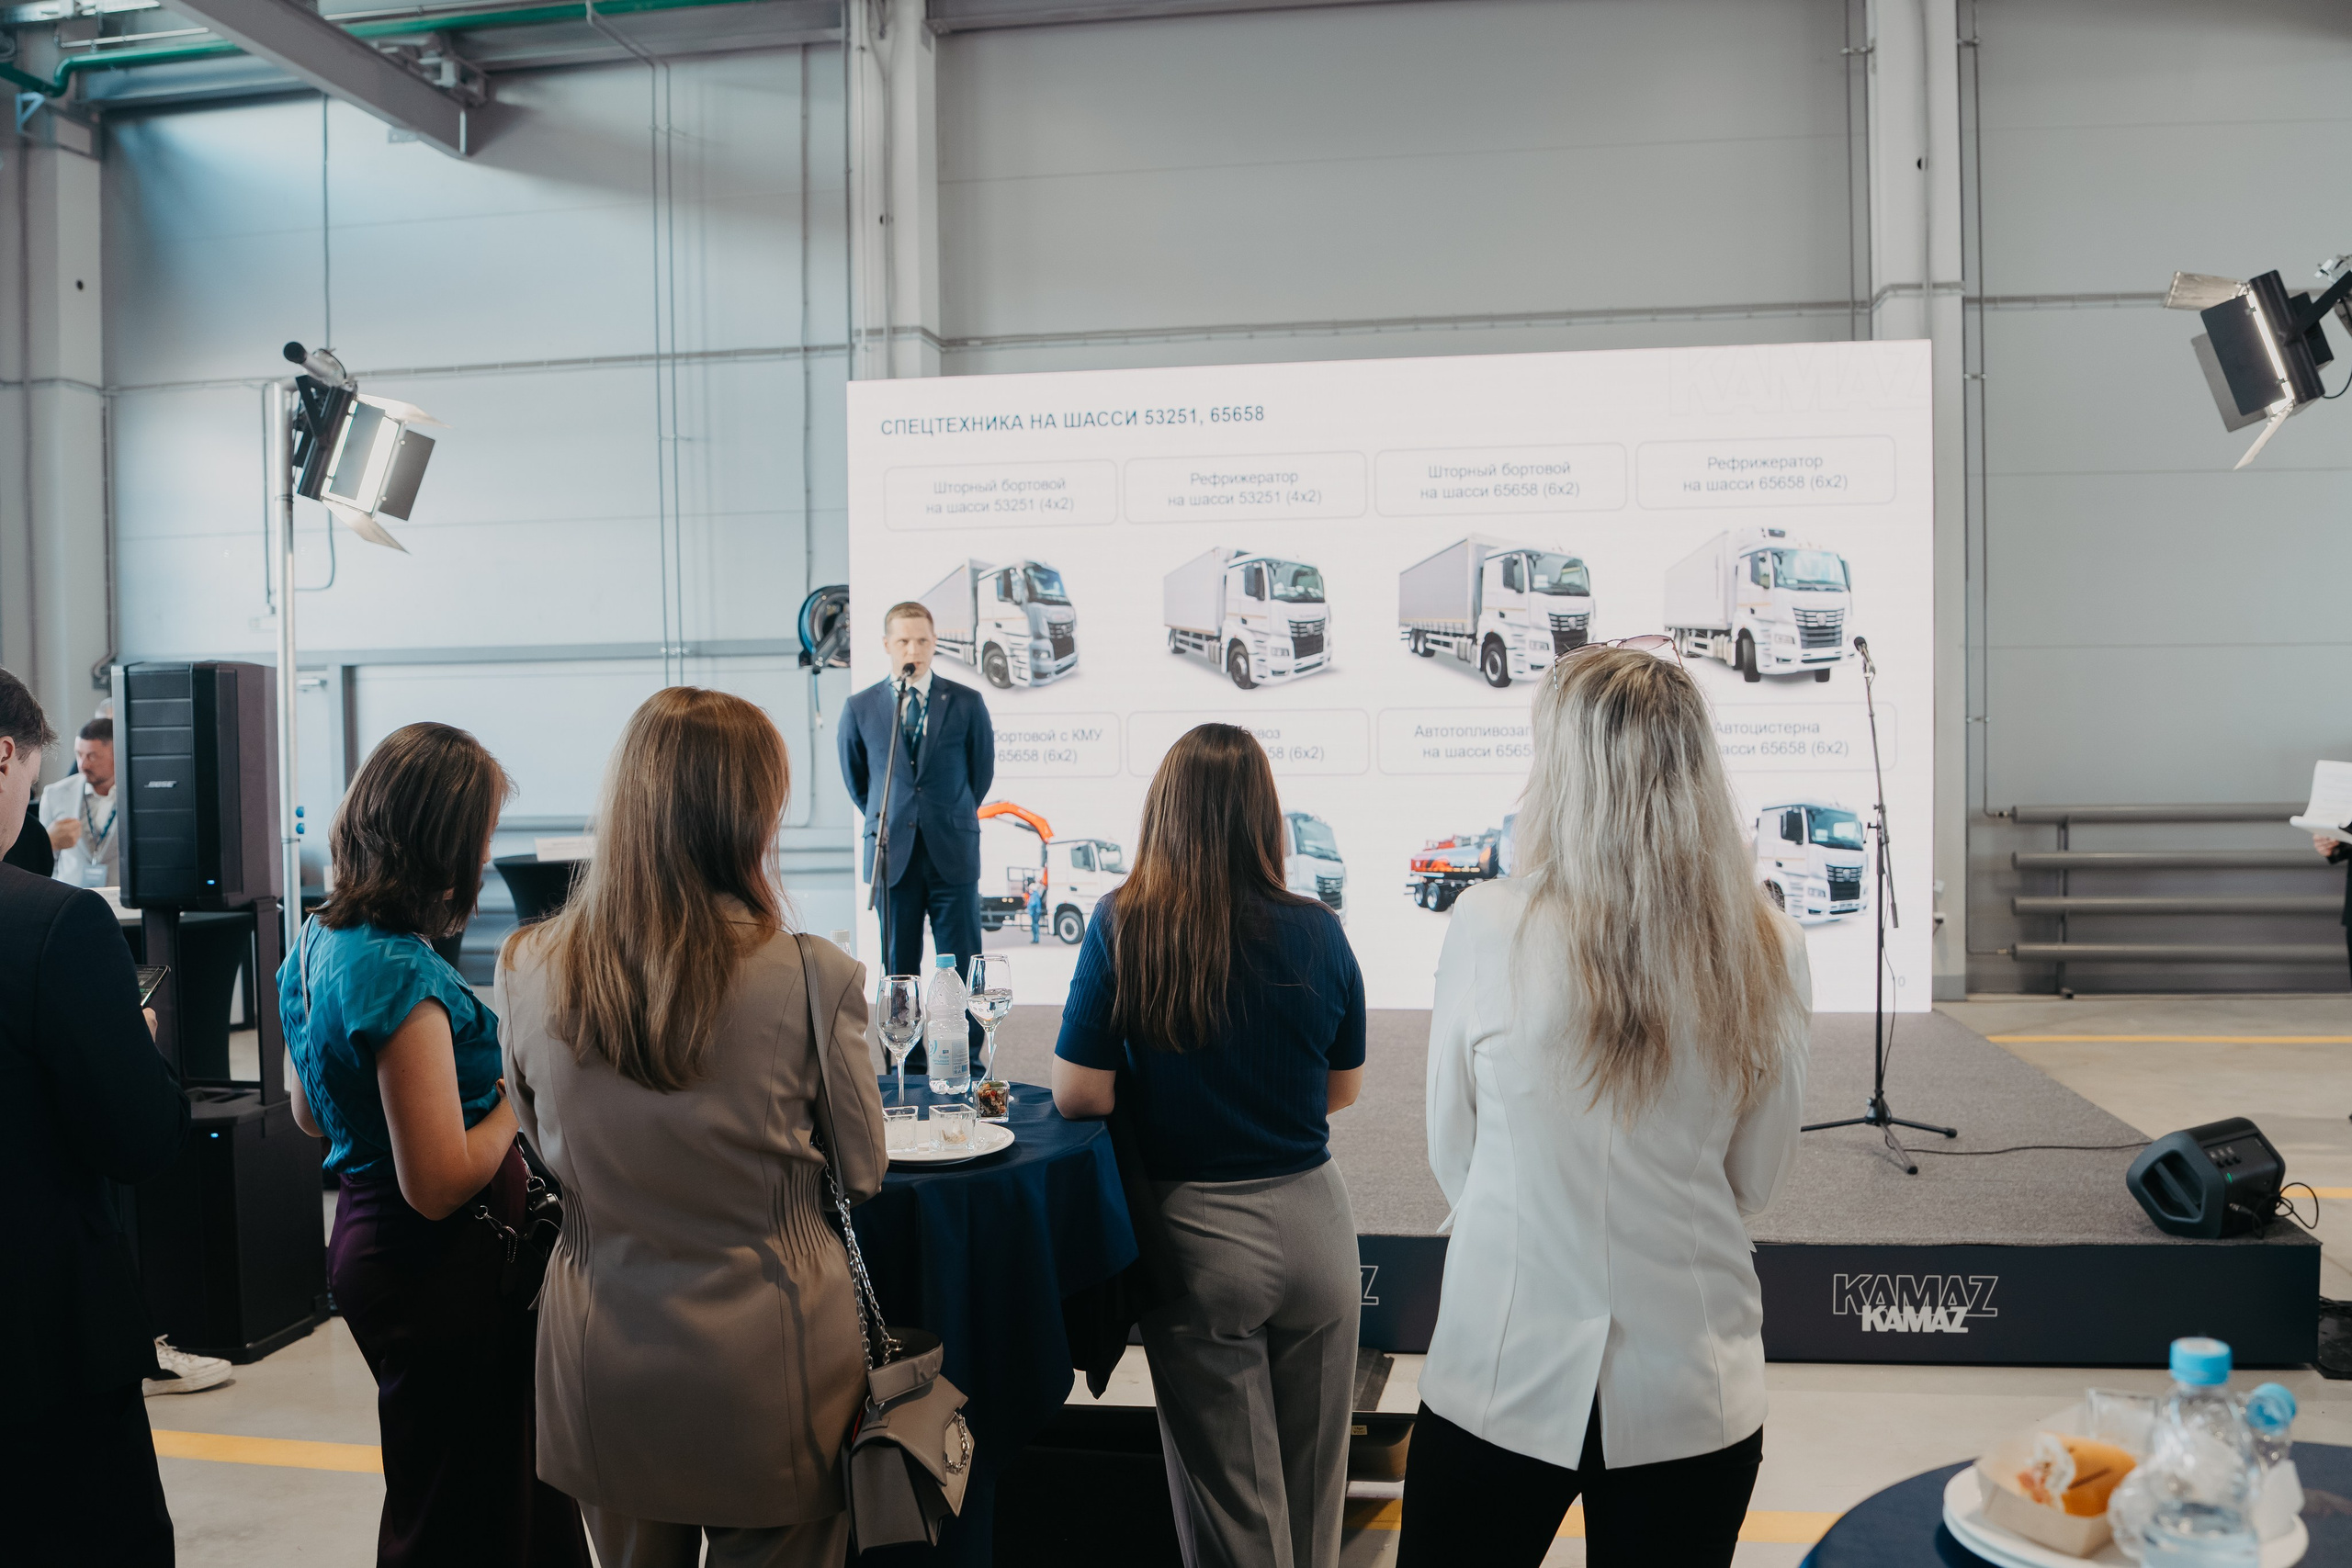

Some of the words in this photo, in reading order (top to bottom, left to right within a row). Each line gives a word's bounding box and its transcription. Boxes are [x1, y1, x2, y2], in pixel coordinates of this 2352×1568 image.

[881, 414, 1023, 436] СПЕЦТЕХНИКА
[1031, 413, 1057, 429] НА
[1064, 411, 1137, 428] ШАССИ
[1145, 408, 1204, 426] 53251,
[1211, 406, 1264, 423] 65658
[1429, 465, 1497, 479] Шторный
[1501, 462, 1571, 478] бортовой
[1708, 457, 1823, 472] Рефрижератор
[1190, 471, 1298, 487] Рефрижератор
[1683, 480, 1701, 491] на
[1707, 479, 1754, 491] шасси
[1759, 476, 1804, 490] 65658
[933, 480, 998, 496] Шторный
[1001, 478, 1066, 493] бортовой
[1420, 488, 1437, 499] на
[1442, 487, 1489, 499] шасси
[1494, 483, 1538, 497] 65658
[926, 502, 942, 513] на
[946, 502, 989, 513] шасси
[994, 499, 1034, 512] 53251
[1168, 495, 1184, 506] на
[1190, 494, 1234, 505] шасси
[1239, 491, 1281, 504] 53251
[1414, 724, 1532, 738] Автотопливозап
[1715, 721, 1820, 736] Автоцистерна
[993, 728, 1057, 745] бортовой
[1072, 728, 1102, 741] КМУ
[998, 750, 1038, 762] 65658
[1423, 746, 1440, 758] на
[1445, 746, 1491, 758] шасси
[1496, 743, 1533, 757] 6565
[1721, 744, 1756, 756] асси
[1760, 741, 1806, 755] 65658
[1833, 1274, 1998, 1316] KAMAZ
[1861, 1304, 1969, 1333] KAMAZ
